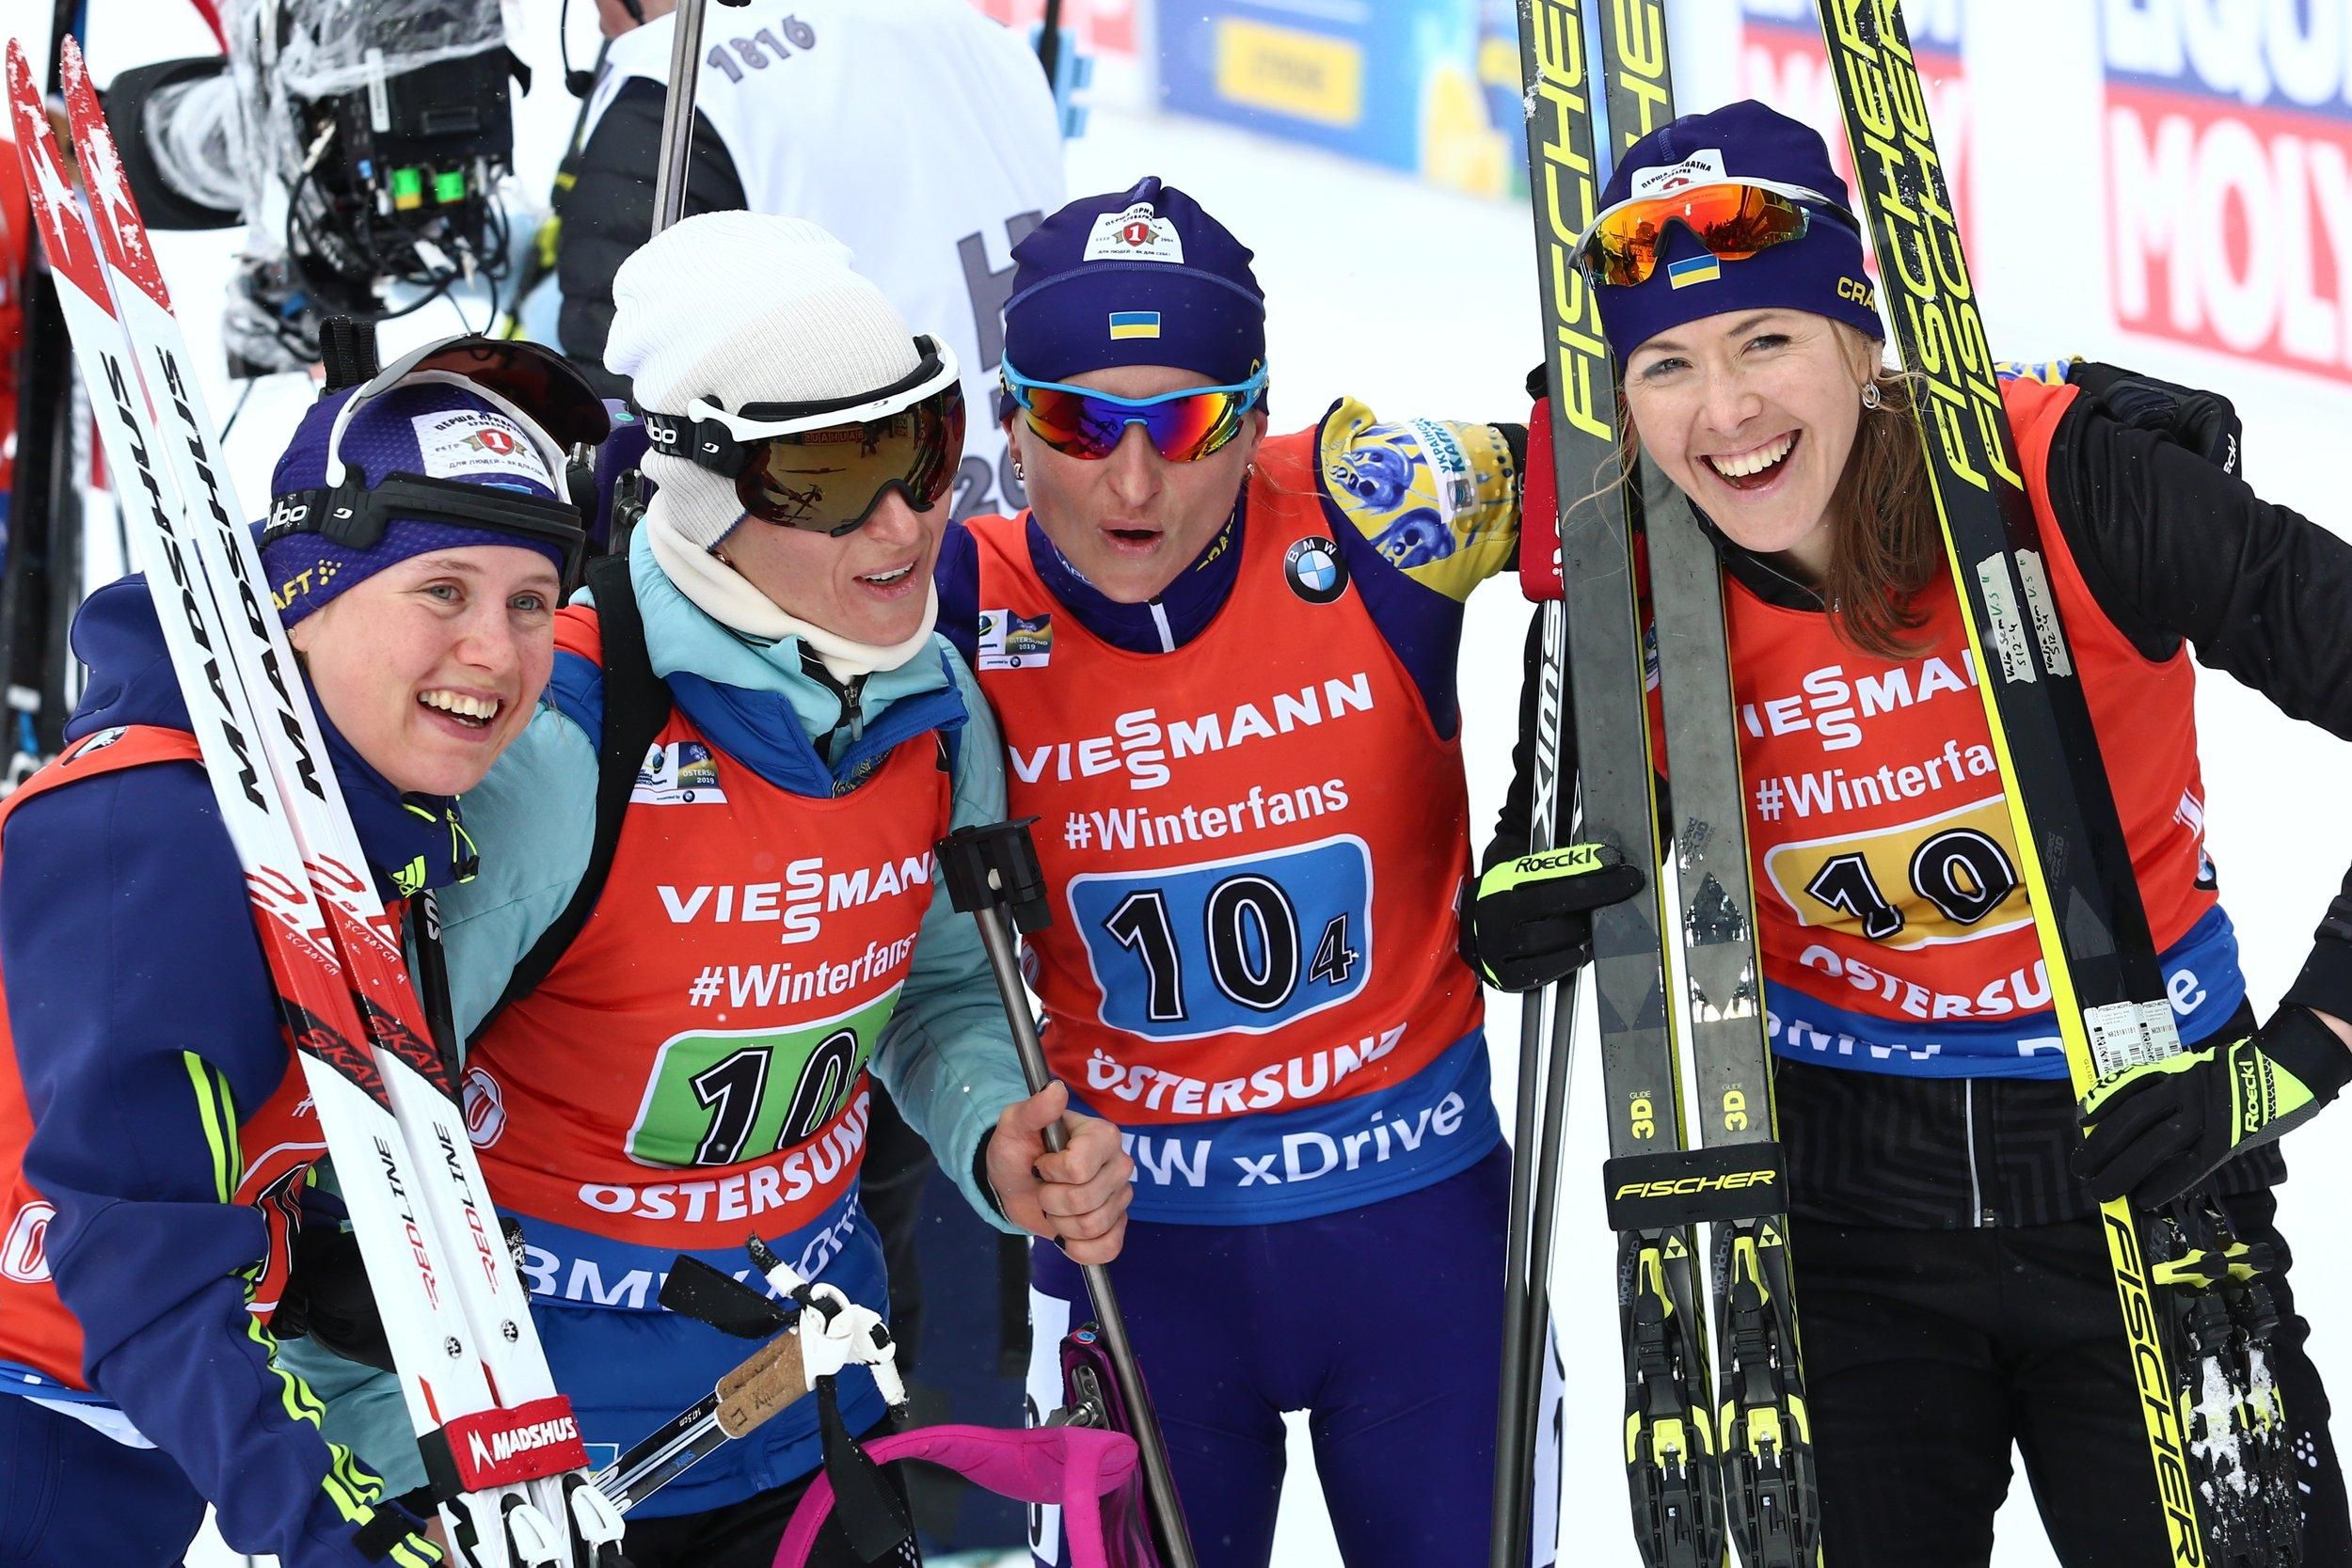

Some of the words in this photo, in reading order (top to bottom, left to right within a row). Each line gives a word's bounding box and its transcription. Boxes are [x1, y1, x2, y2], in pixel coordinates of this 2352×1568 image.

[707, 14, 816, 84] 1816
[1129, 225, 1142, 242] 1
[1532, 0, 1613, 442] FISCHE
[1836, 276, 1877, 313] CRA
[486, 432, 509, 451] 1
[263, 500, 308, 533] ulbo
[1287, 538, 1338, 563] BMW
[100, 350, 269, 815] MADSHUS
[155, 344, 326, 802] MADSHUS
[272, 567, 313, 610] AFT
[1007, 673, 1375, 790] VIESSMANN
[1742, 649, 1980, 752] IESSMA
[1064, 778, 1349, 851] #Winterfans
[1756, 738, 1996, 822] #Winterfa
[656, 848, 939, 944] VIESSMAN
[1804, 828, 2016, 940] 10
[688, 931, 917, 1008] #Winterfans
[1104, 873, 1300, 1023] 10
[1309, 912, 1359, 984] 4
[688, 1027, 859, 1167] 10
[1629, 1090, 1652, 1100] GLIDE
[1630, 1099, 1656, 1140] 3D
[1722, 1082, 1743, 1091] GLIDE
[1723, 1090, 1748, 1132] 3D
[1232, 1091, 1466, 1188] xDrive
[373, 1134, 439, 1311] REDLINE
[432, 1120, 499, 1295] REDLINE
[1614, 1169, 1776, 1202] FISCHER
[523, 1243, 670, 1310] BM
[2105, 1213, 2201, 1568] FISCHER
[491, 1416, 578, 1462] MADSHUS
